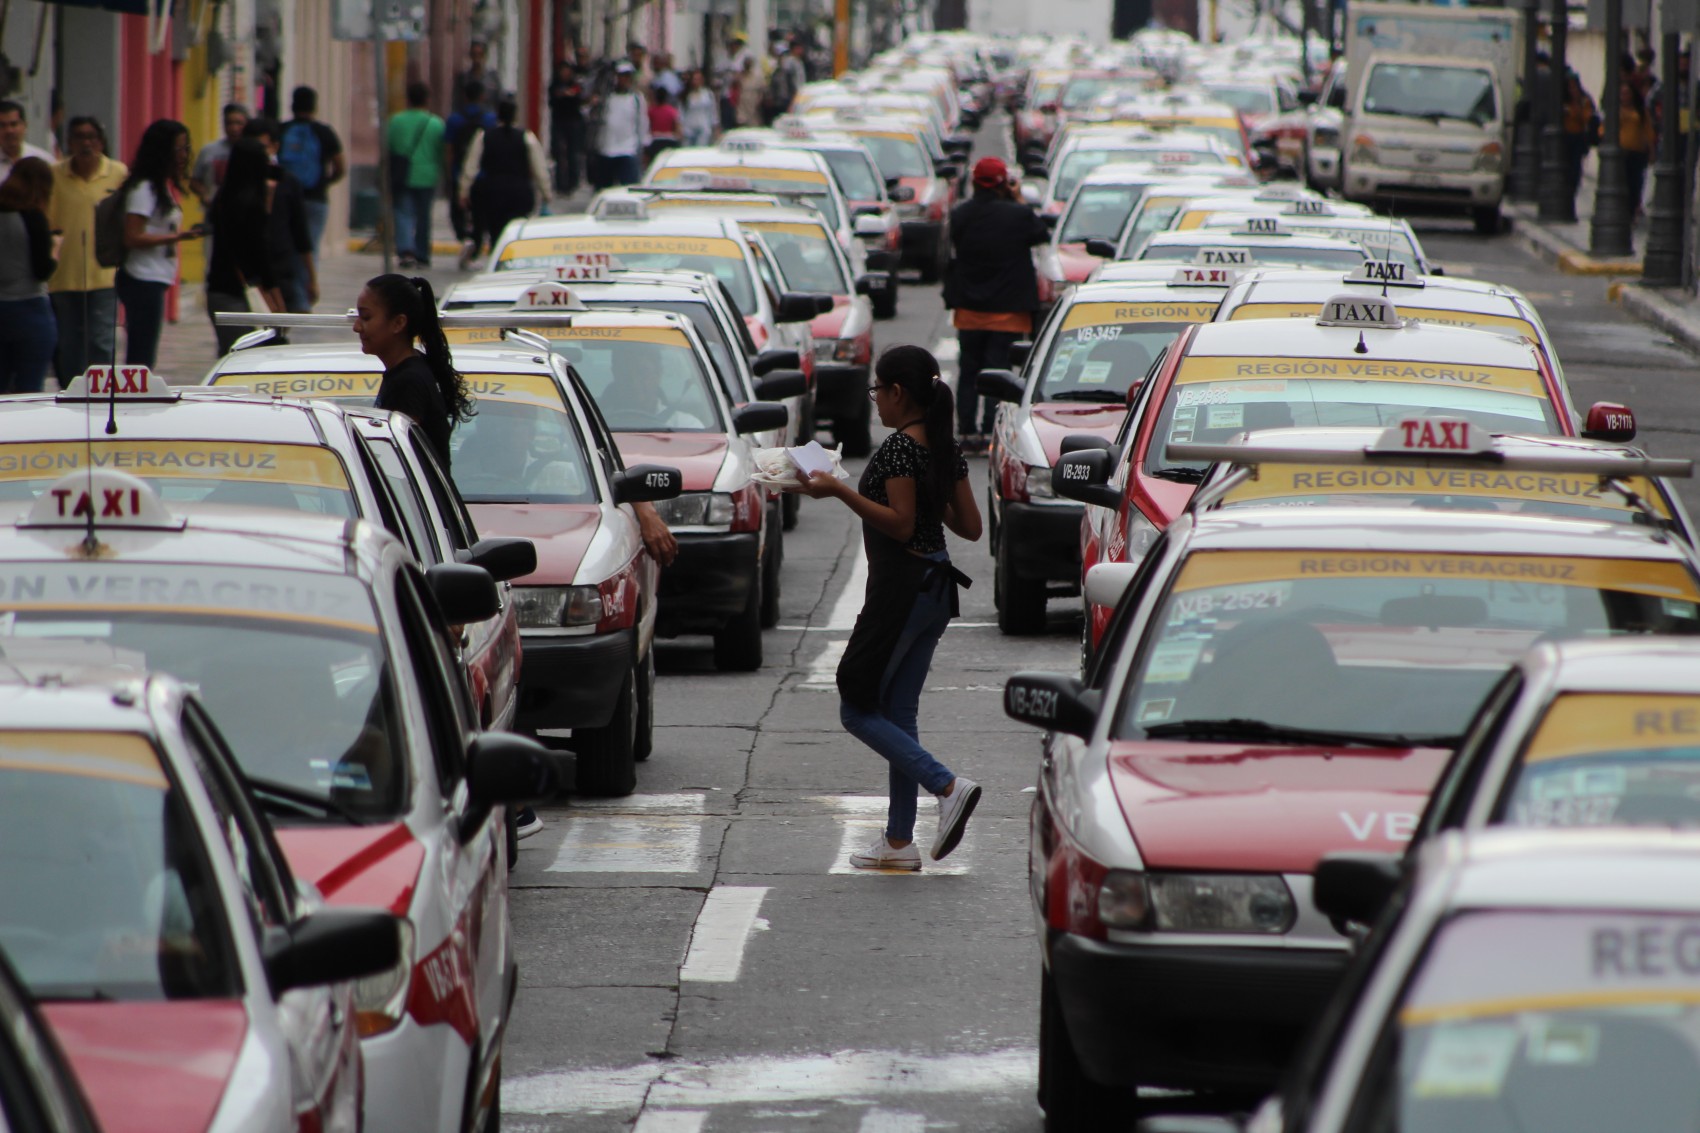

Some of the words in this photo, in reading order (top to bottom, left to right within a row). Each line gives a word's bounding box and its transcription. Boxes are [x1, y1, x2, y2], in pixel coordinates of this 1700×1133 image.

[1296, 201, 1322, 213] TAXI
[1247, 219, 1277, 232] TAXI
[621, 240, 708, 252] VERACRUZ
[1204, 252, 1245, 264] TAXI
[556, 267, 600, 279] TAXI
[1184, 270, 1226, 282] TAXI
[1365, 262, 1405, 280] TAXI
[1115, 305, 1189, 319] REGIÓN
[1332, 303, 1386, 322] TAXI
[537, 327, 622, 338] VERACRUZ
[1077, 326, 1122, 342] VB-3457
[87, 367, 149, 394] TAXI
[1237, 361, 1338, 376] REGIÓN
[1347, 364, 1492, 385] VERACRUZ
[254, 376, 353, 395] REGIÓN
[1400, 419, 1470, 450] TAXI
[91, 451, 277, 470] VERACRUZ
[645, 473, 670, 487] 4765
[1063, 463, 1091, 480] VB-2933
[1293, 467, 1415, 489] REGIÓN
[1426, 471, 1602, 499] VERACRUZ
[51, 489, 140, 517] TAXI
[1300, 556, 1412, 574] REGIÓN
[1420, 559, 1576, 580] VERACRUZ
[66, 574, 348, 612] VERACRUZ
[1177, 589, 1284, 616] VB-2521
[1010, 685, 1059, 719] VB-2521
